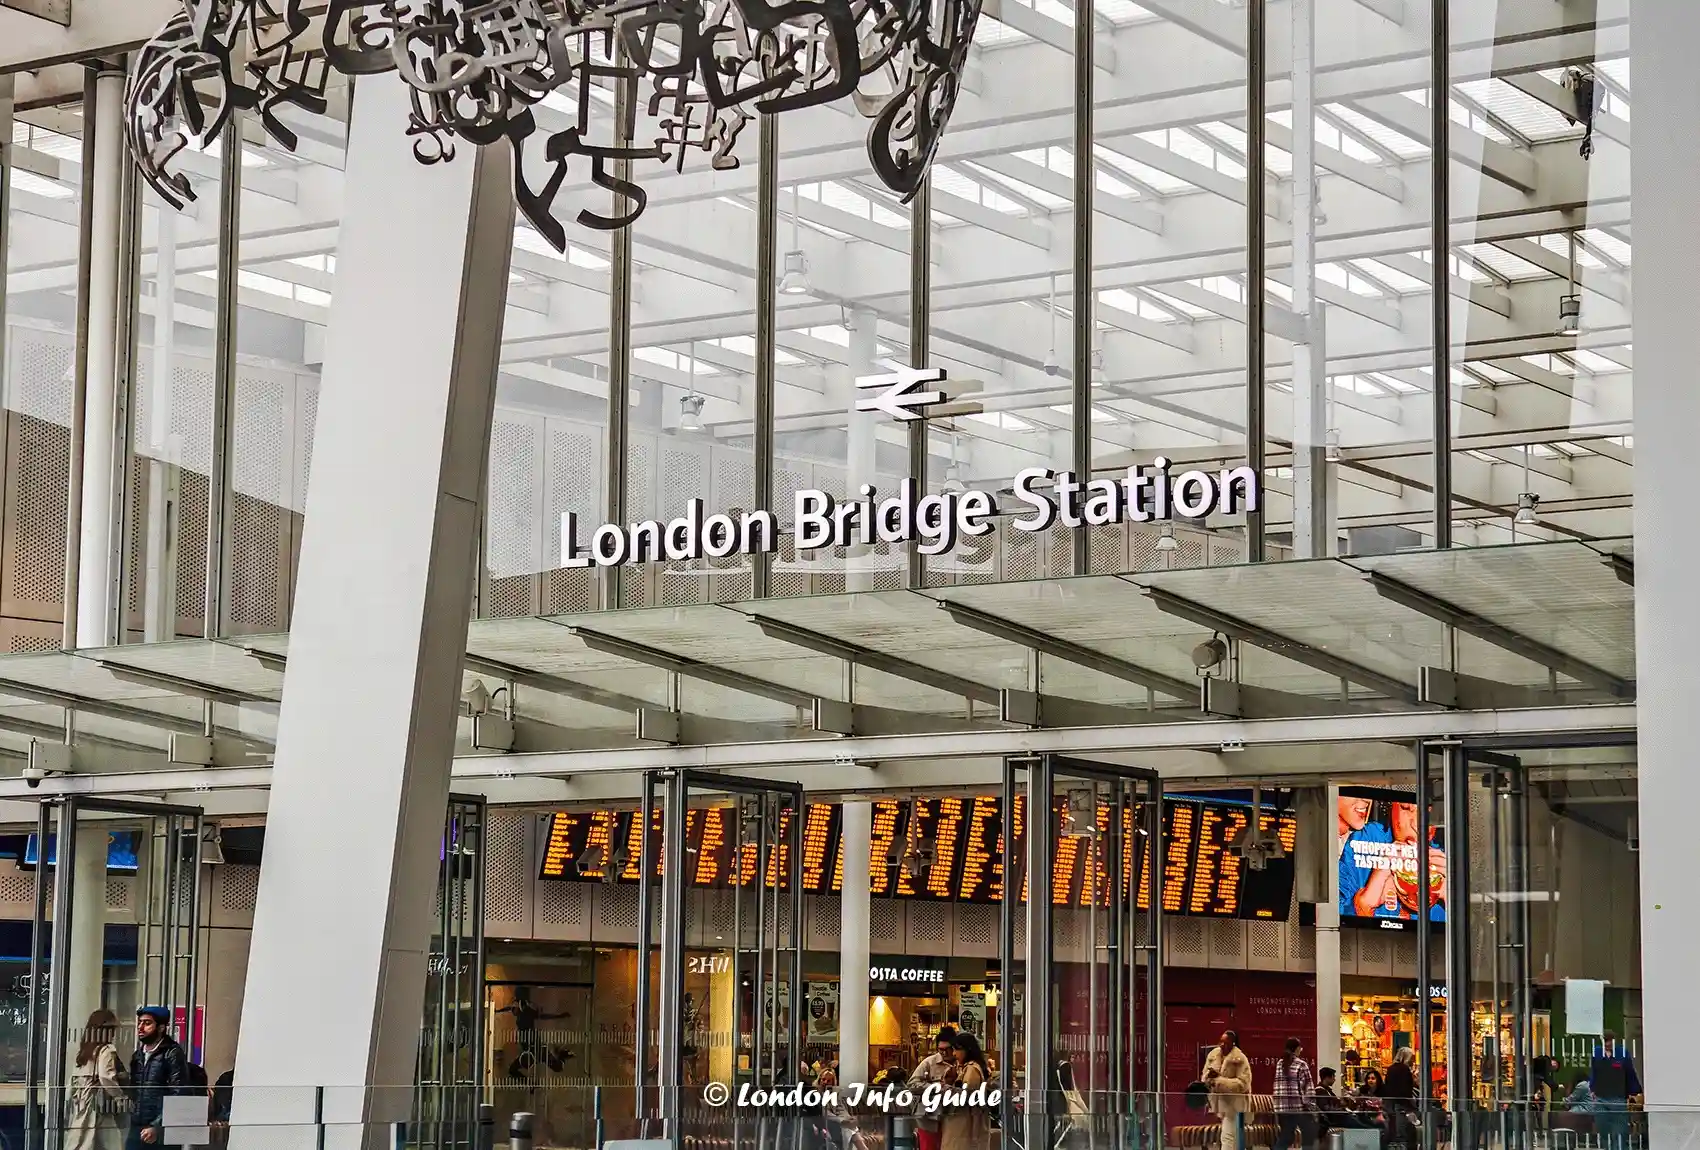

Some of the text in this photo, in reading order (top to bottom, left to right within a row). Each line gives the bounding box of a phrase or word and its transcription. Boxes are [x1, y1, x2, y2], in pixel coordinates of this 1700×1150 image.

[559, 457, 1259, 570] London Bridge Station
[1404, 859, 1418, 873] GO
[869, 966, 944, 982] OSTA COFFEE
